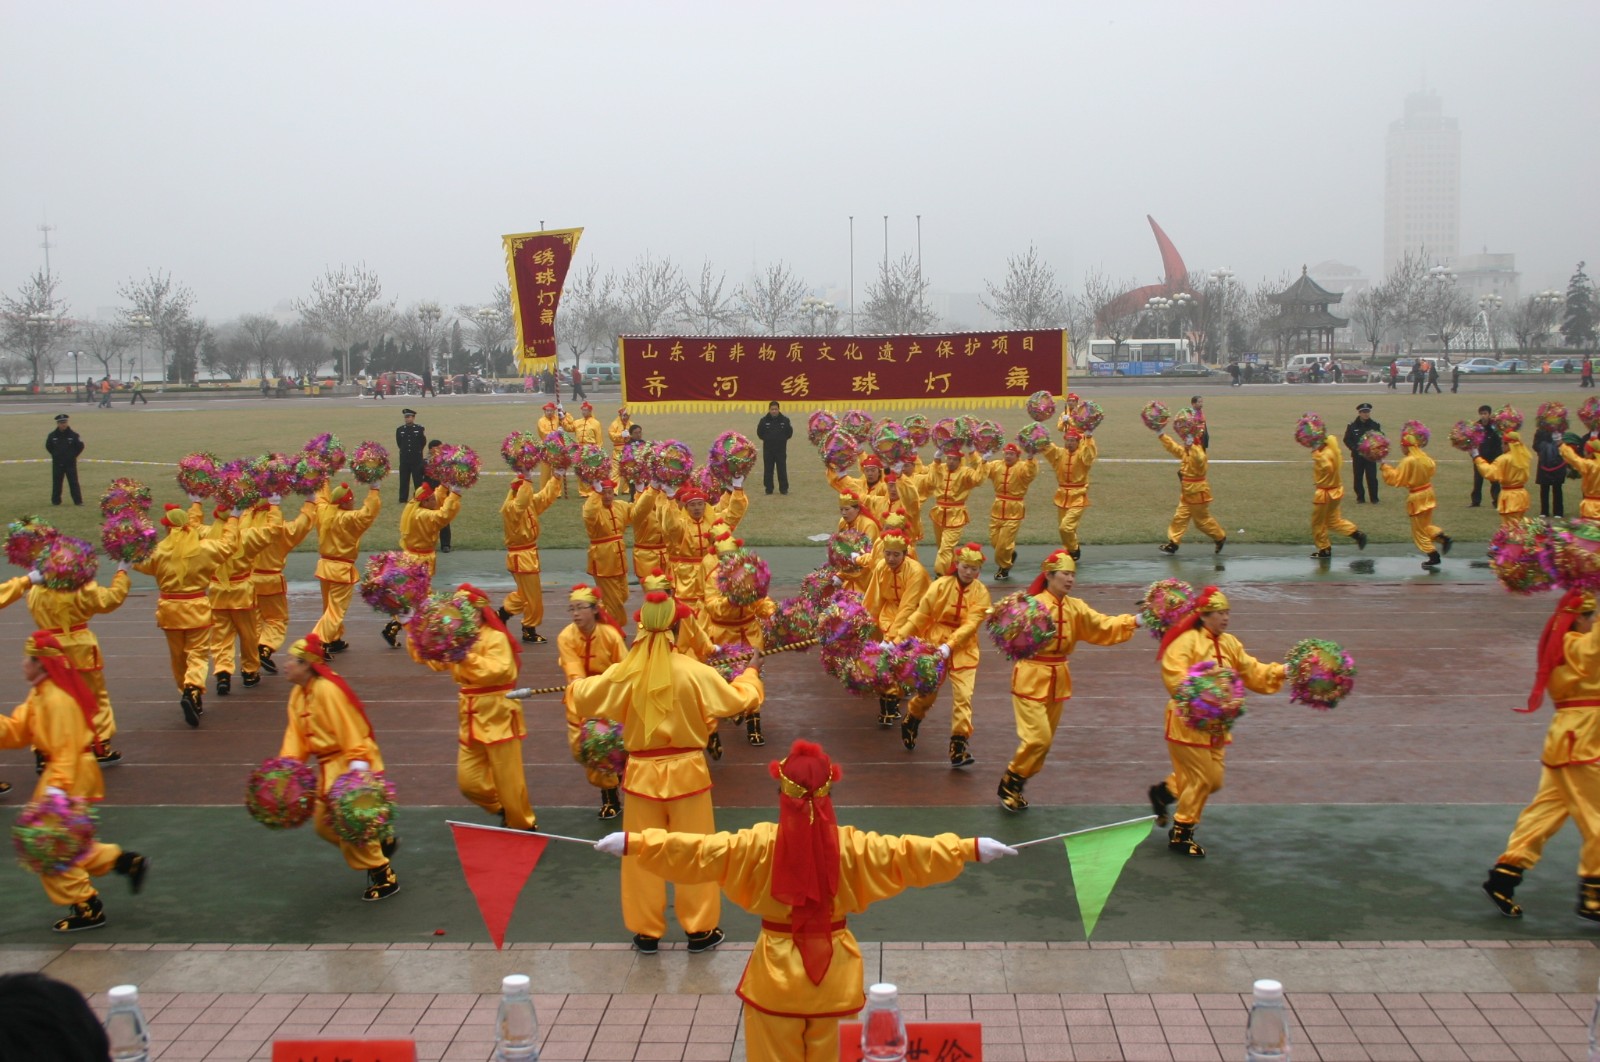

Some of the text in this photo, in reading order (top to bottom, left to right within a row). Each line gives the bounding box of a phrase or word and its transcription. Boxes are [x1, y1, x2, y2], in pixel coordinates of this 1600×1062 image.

[532, 247, 557, 327] 绣球灯舞
[641, 335, 1034, 363] 山东省非物质文化遗产保护项目
[642, 366, 1031, 398] 齐河绣球灯舞
